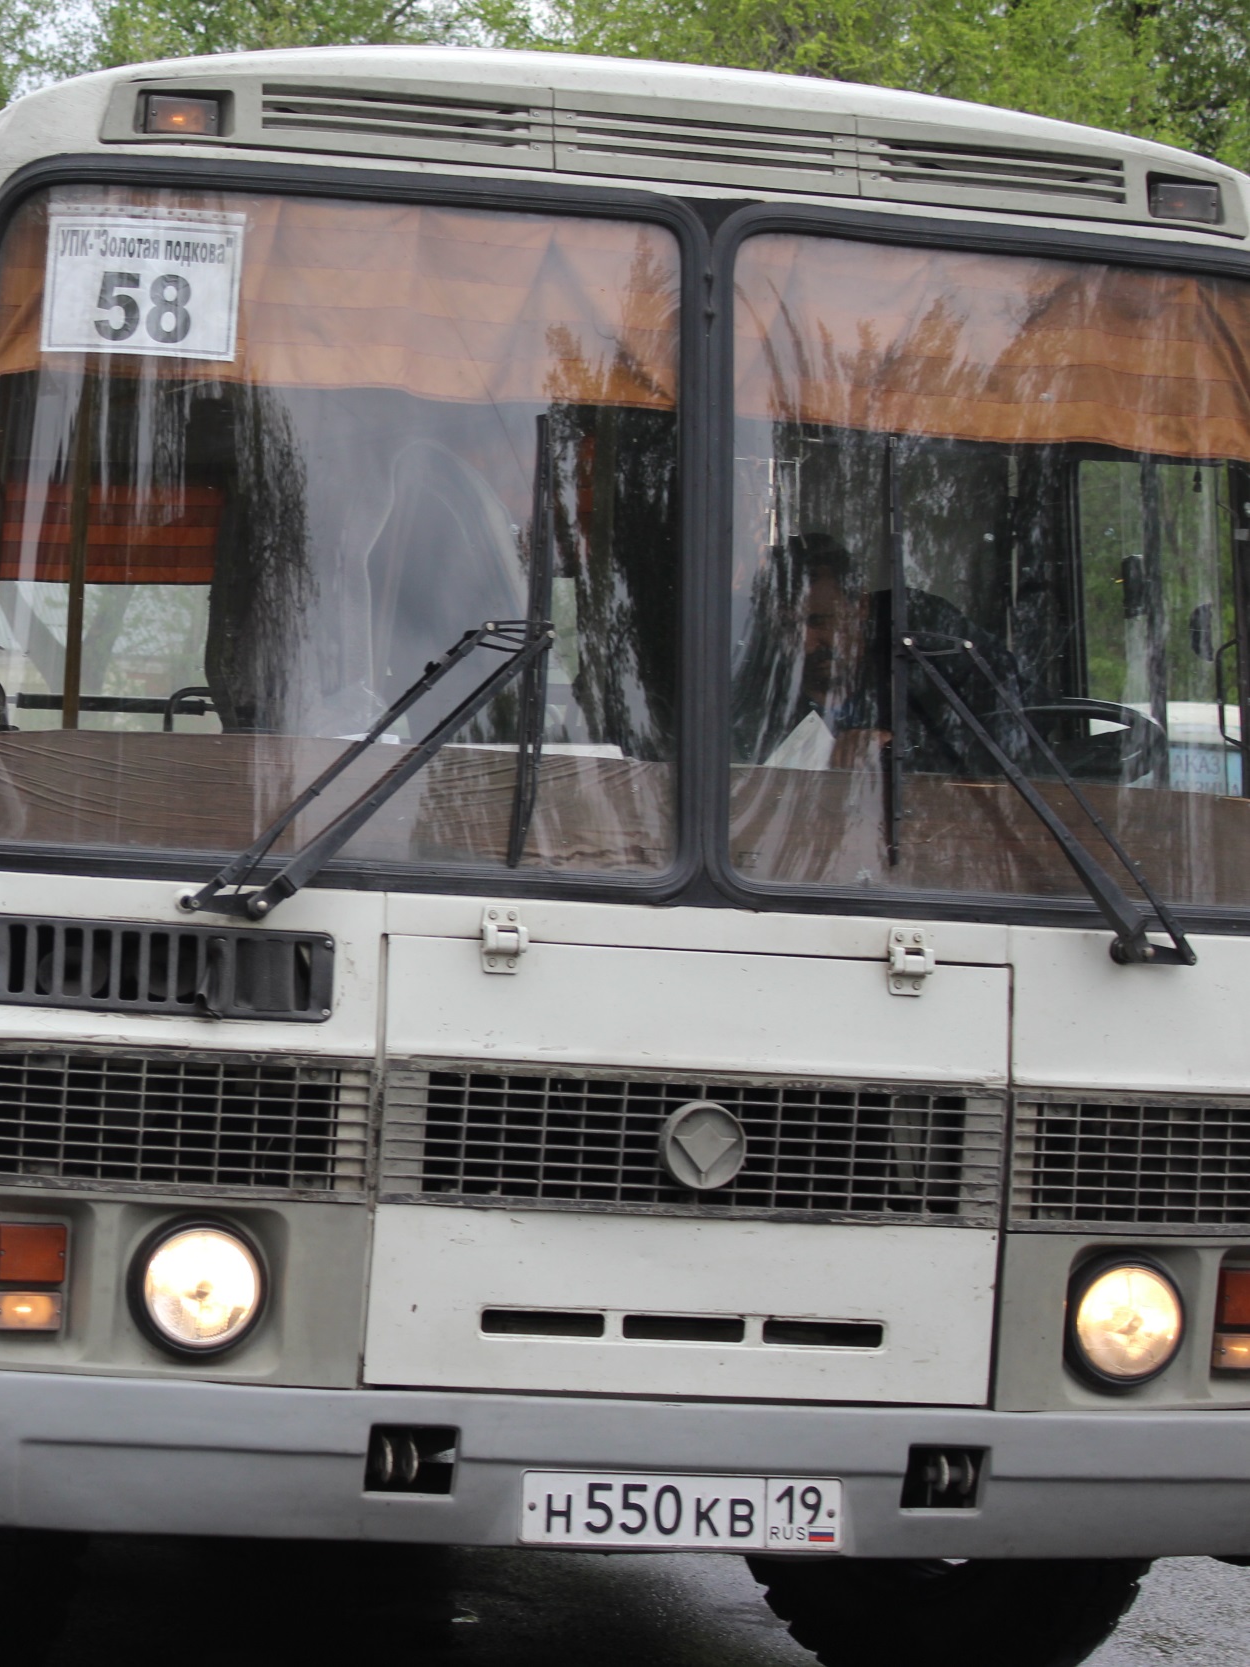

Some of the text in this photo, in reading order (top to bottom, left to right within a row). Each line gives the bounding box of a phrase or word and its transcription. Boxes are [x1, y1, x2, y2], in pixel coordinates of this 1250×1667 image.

[94, 271, 192, 344] 58
[546, 1482, 822, 1538] Н550КВ 19
[769, 1526, 806, 1541] RUS
